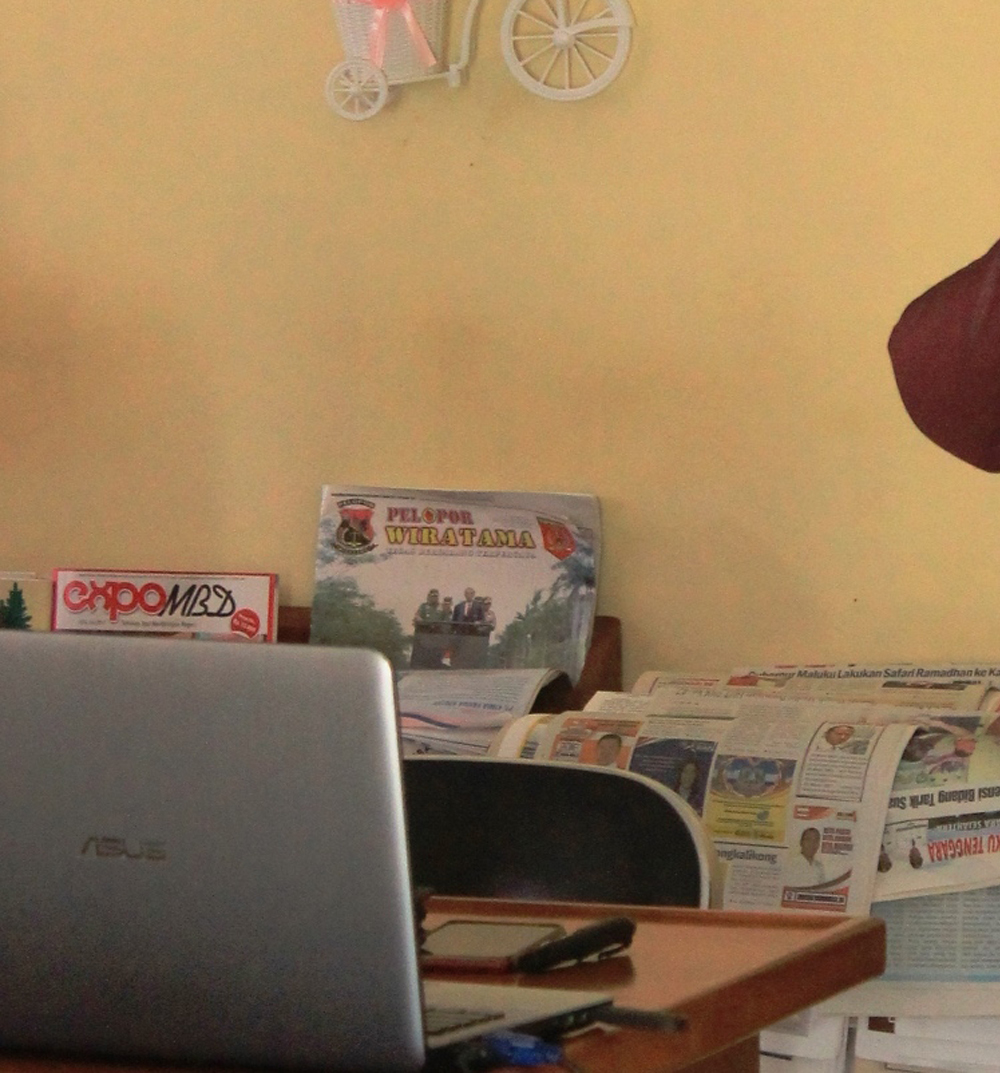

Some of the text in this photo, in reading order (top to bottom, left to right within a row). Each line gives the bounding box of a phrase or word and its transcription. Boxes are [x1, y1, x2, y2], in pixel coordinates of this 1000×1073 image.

[386, 506, 474, 525] PELOPOR
[384, 525, 536, 549] WIRATAMA
[796, 669, 836, 678] Maluku
[837, 669, 882, 678] Lakukan
[882, 668, 915, 678] Safari
[915, 668, 973, 678] Ramadhan
[974, 668, 986, 677] ke
[910, 793, 935, 809] Tarik
[938, 788, 975, 803] Bidang
[81, 836, 167, 861] ASUS
[928, 836, 984, 863] TENGGARA
